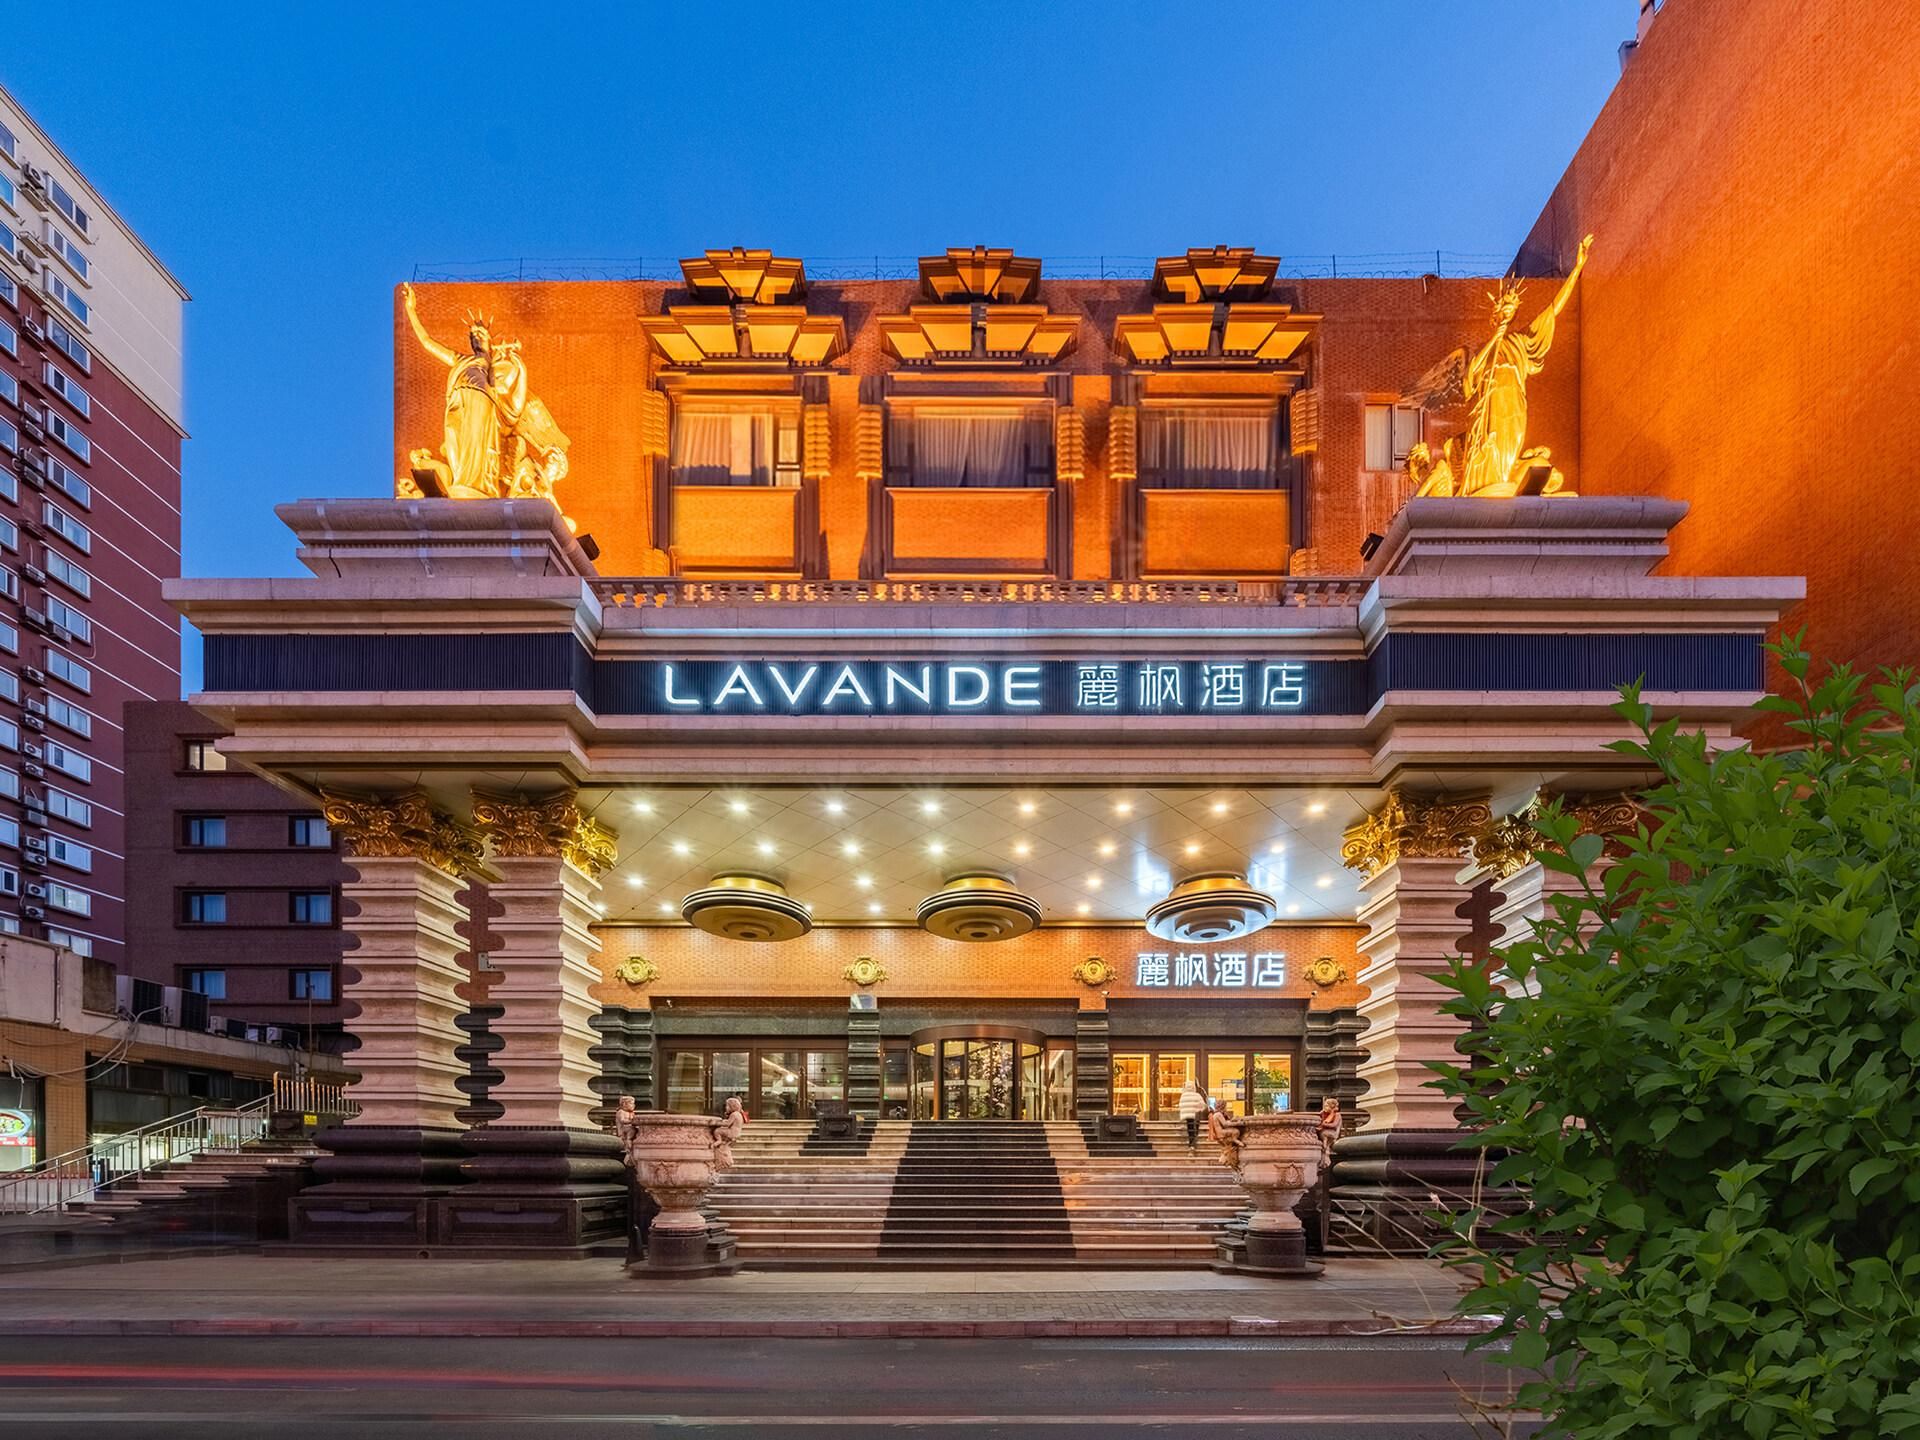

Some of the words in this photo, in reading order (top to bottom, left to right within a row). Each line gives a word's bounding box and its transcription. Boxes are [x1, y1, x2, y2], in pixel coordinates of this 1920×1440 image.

[664, 664, 1041, 706] LAVANDE
[1076, 663, 1305, 707] 麗枫酒店
[1136, 952, 1286, 987] 麗枫酒店
